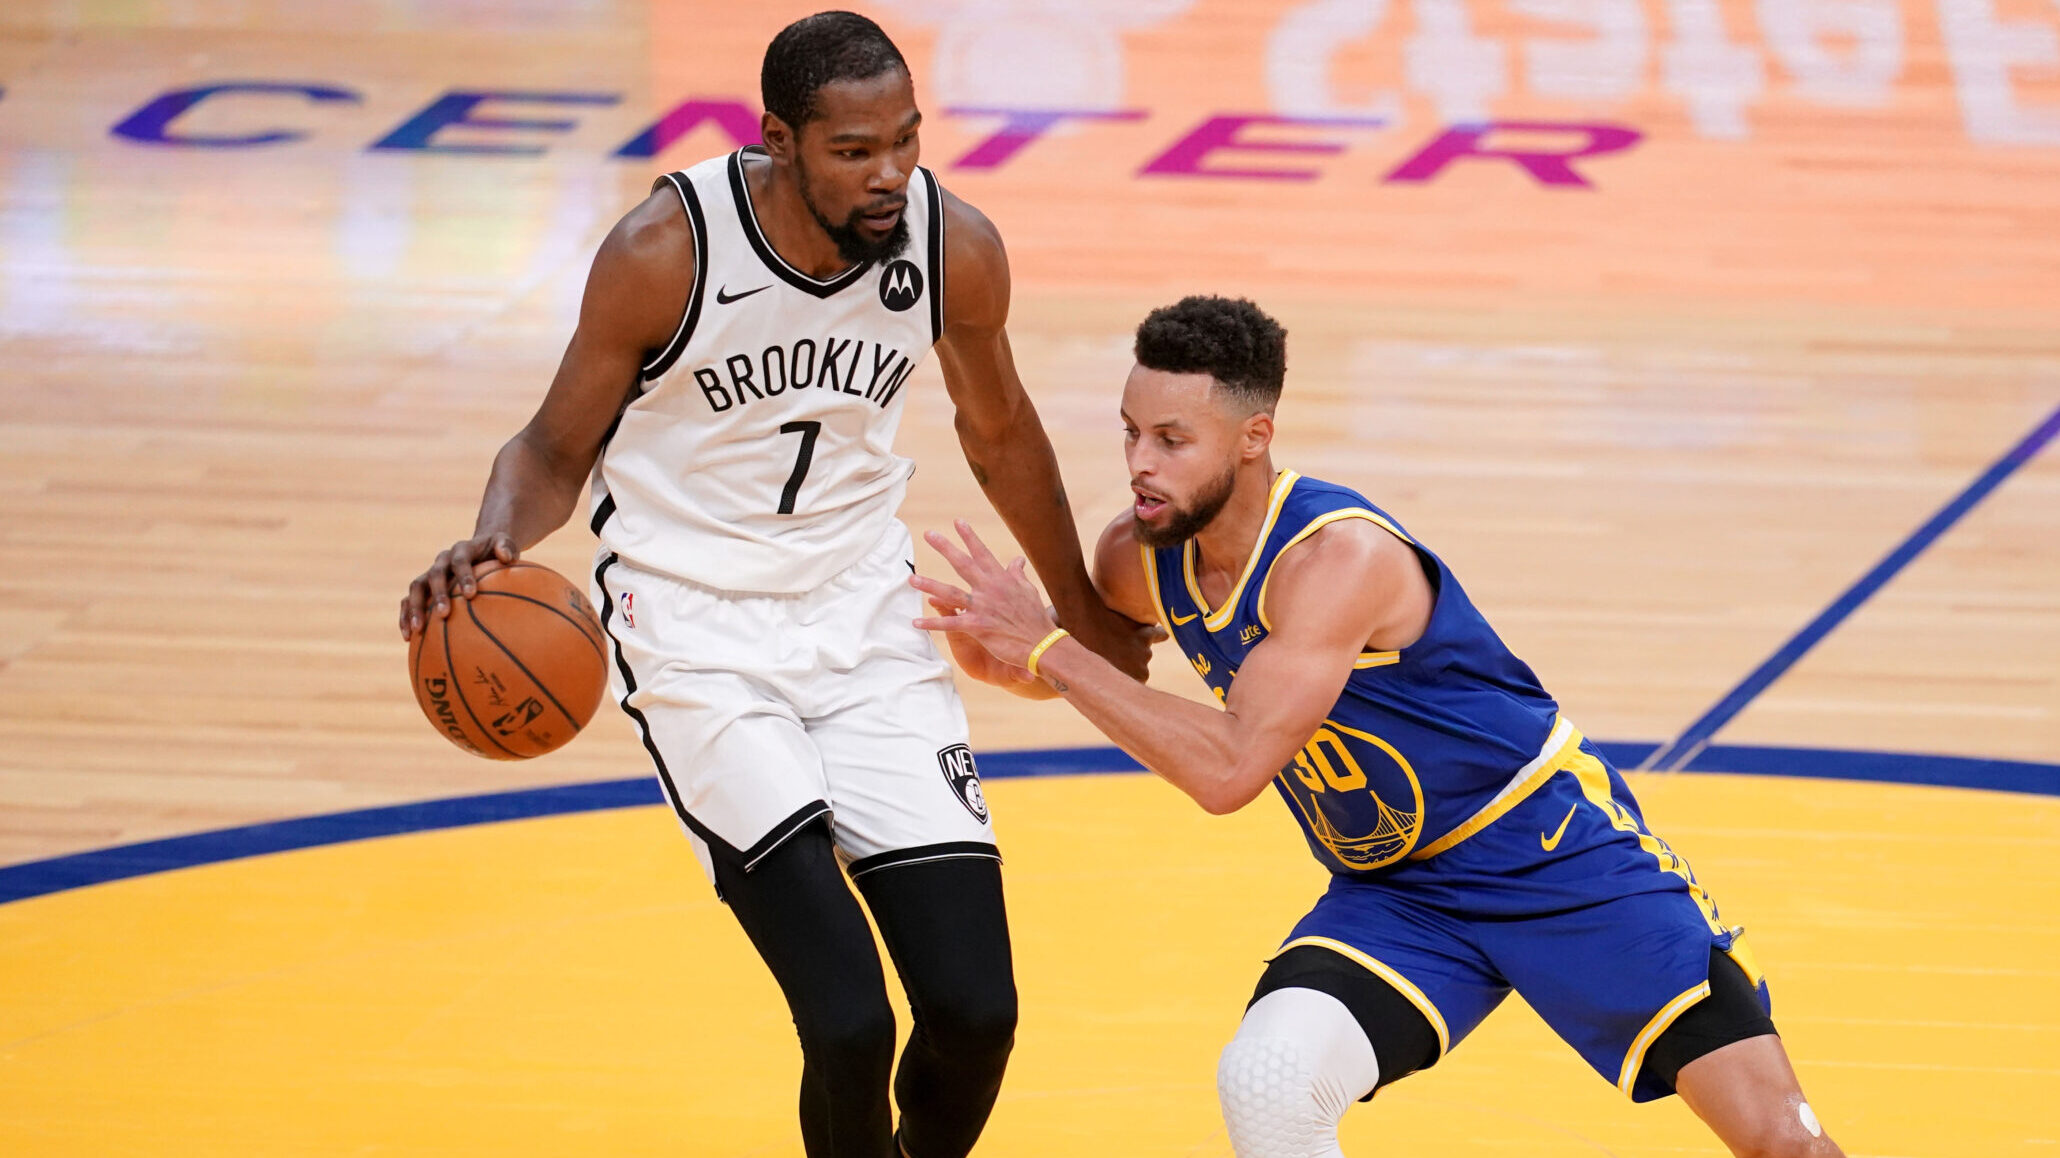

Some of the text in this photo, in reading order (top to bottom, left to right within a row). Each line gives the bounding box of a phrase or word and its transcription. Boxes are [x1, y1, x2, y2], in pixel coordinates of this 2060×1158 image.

[693, 337, 915, 413] BROOKLYN
[777, 420, 821, 514] 7
[1240, 624, 1262, 641] ute
[1191, 653, 1211, 678] he
[945, 749, 974, 780] NE
[1293, 728, 1367, 794] 30
